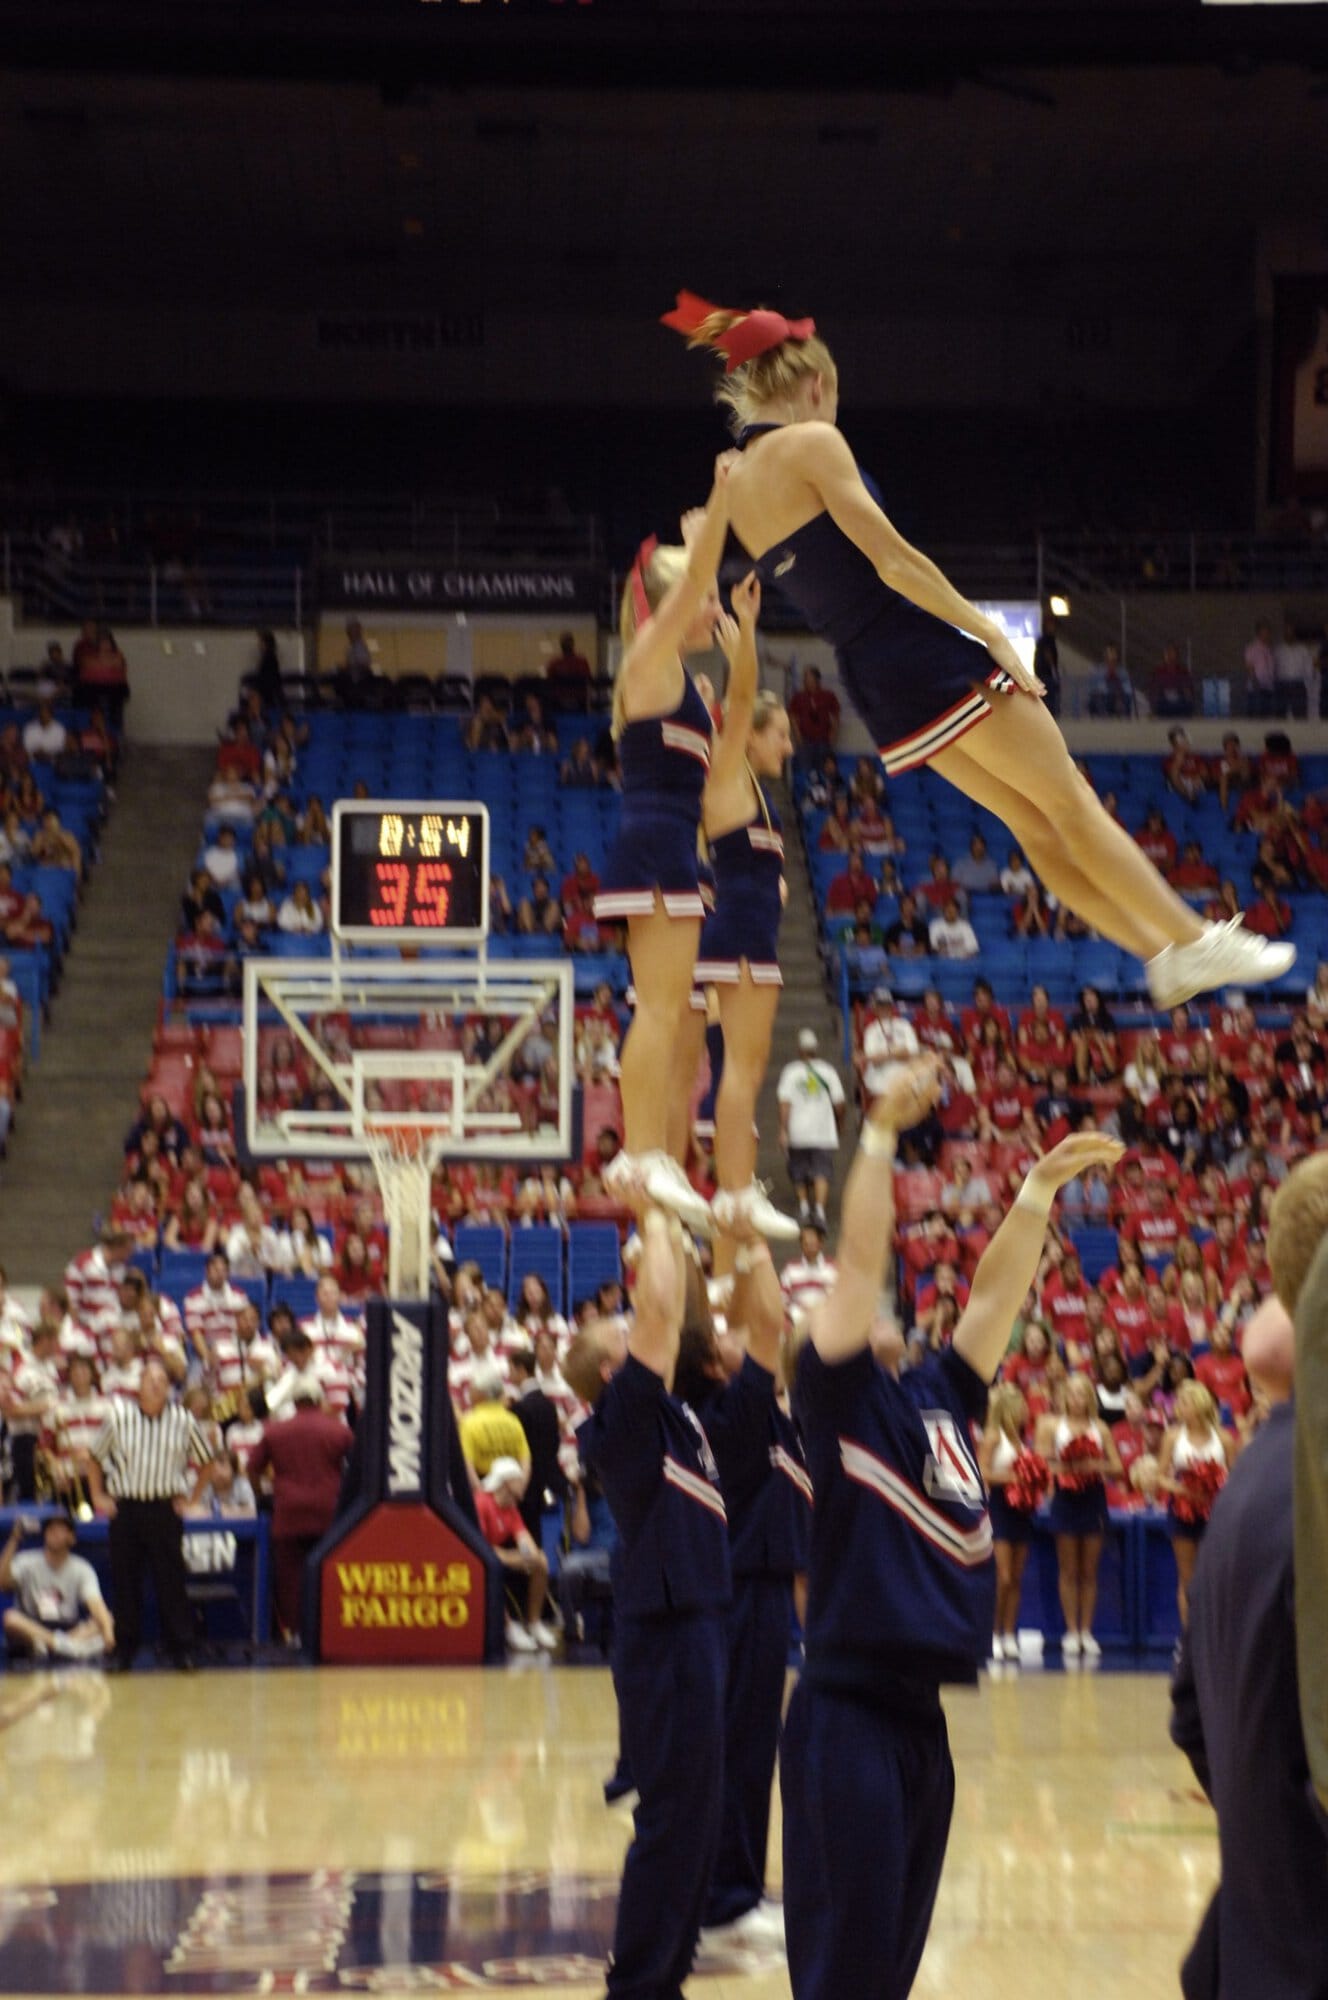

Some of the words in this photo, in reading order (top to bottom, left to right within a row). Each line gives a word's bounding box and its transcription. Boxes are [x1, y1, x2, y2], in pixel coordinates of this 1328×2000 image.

[343, 571, 398, 595] HALL
[408, 571, 432, 596] OF
[443, 571, 574, 597] CHAMPIONS
[370, 863, 452, 926] 35
[388, 1309, 423, 1495] ARIZONA
[336, 1562, 472, 1595] WELLS
[340, 1596, 469, 1629] FARGO
